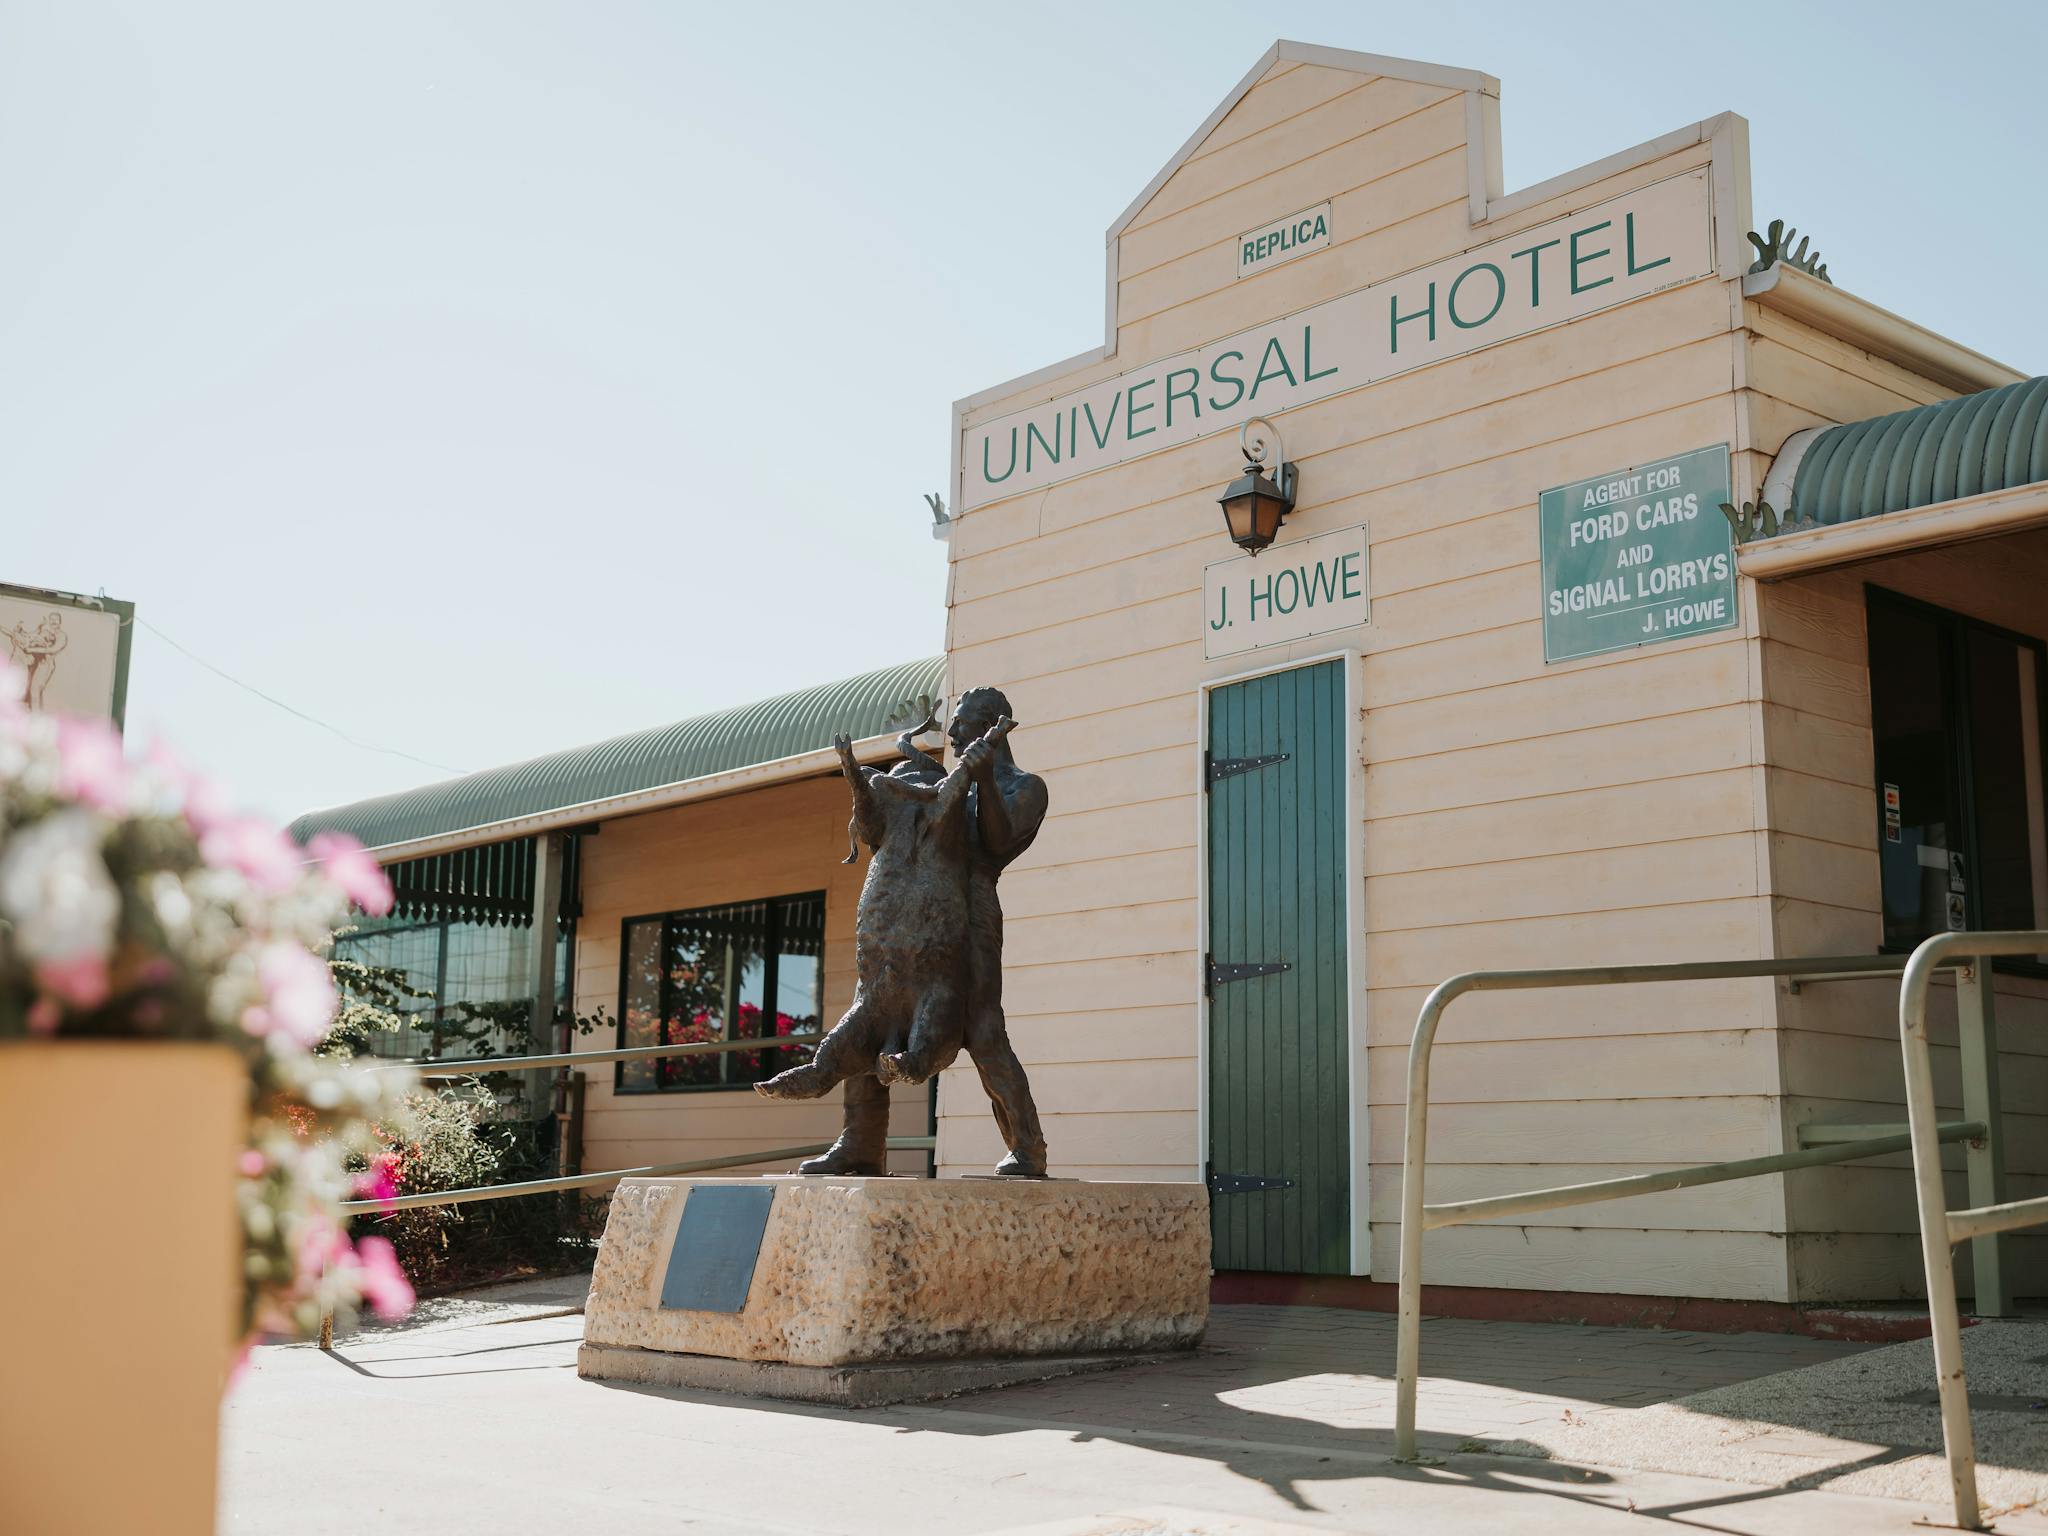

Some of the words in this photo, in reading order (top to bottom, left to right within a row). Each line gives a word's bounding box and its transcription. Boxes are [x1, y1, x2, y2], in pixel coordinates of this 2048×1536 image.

[1242, 214, 1327, 266] REPLICA
[983, 325, 1338, 483] UNIVERSAL
[1390, 212, 1670, 353] HOTEL
[1583, 476, 1642, 508] AGENT
[1646, 466, 1681, 491] FOR
[1570, 511, 1629, 548] FORD
[1635, 493, 1699, 531] CARS
[1616, 544, 1654, 568] AND
[1210, 586, 1233, 630] J.
[1250, 551, 1361, 622] HOWE
[1549, 576, 1631, 616] SIGNAL
[1637, 553, 1729, 598] LORRYS
[1642, 613, 1659, 633] J.
[1665, 598, 1726, 628] HOWE
